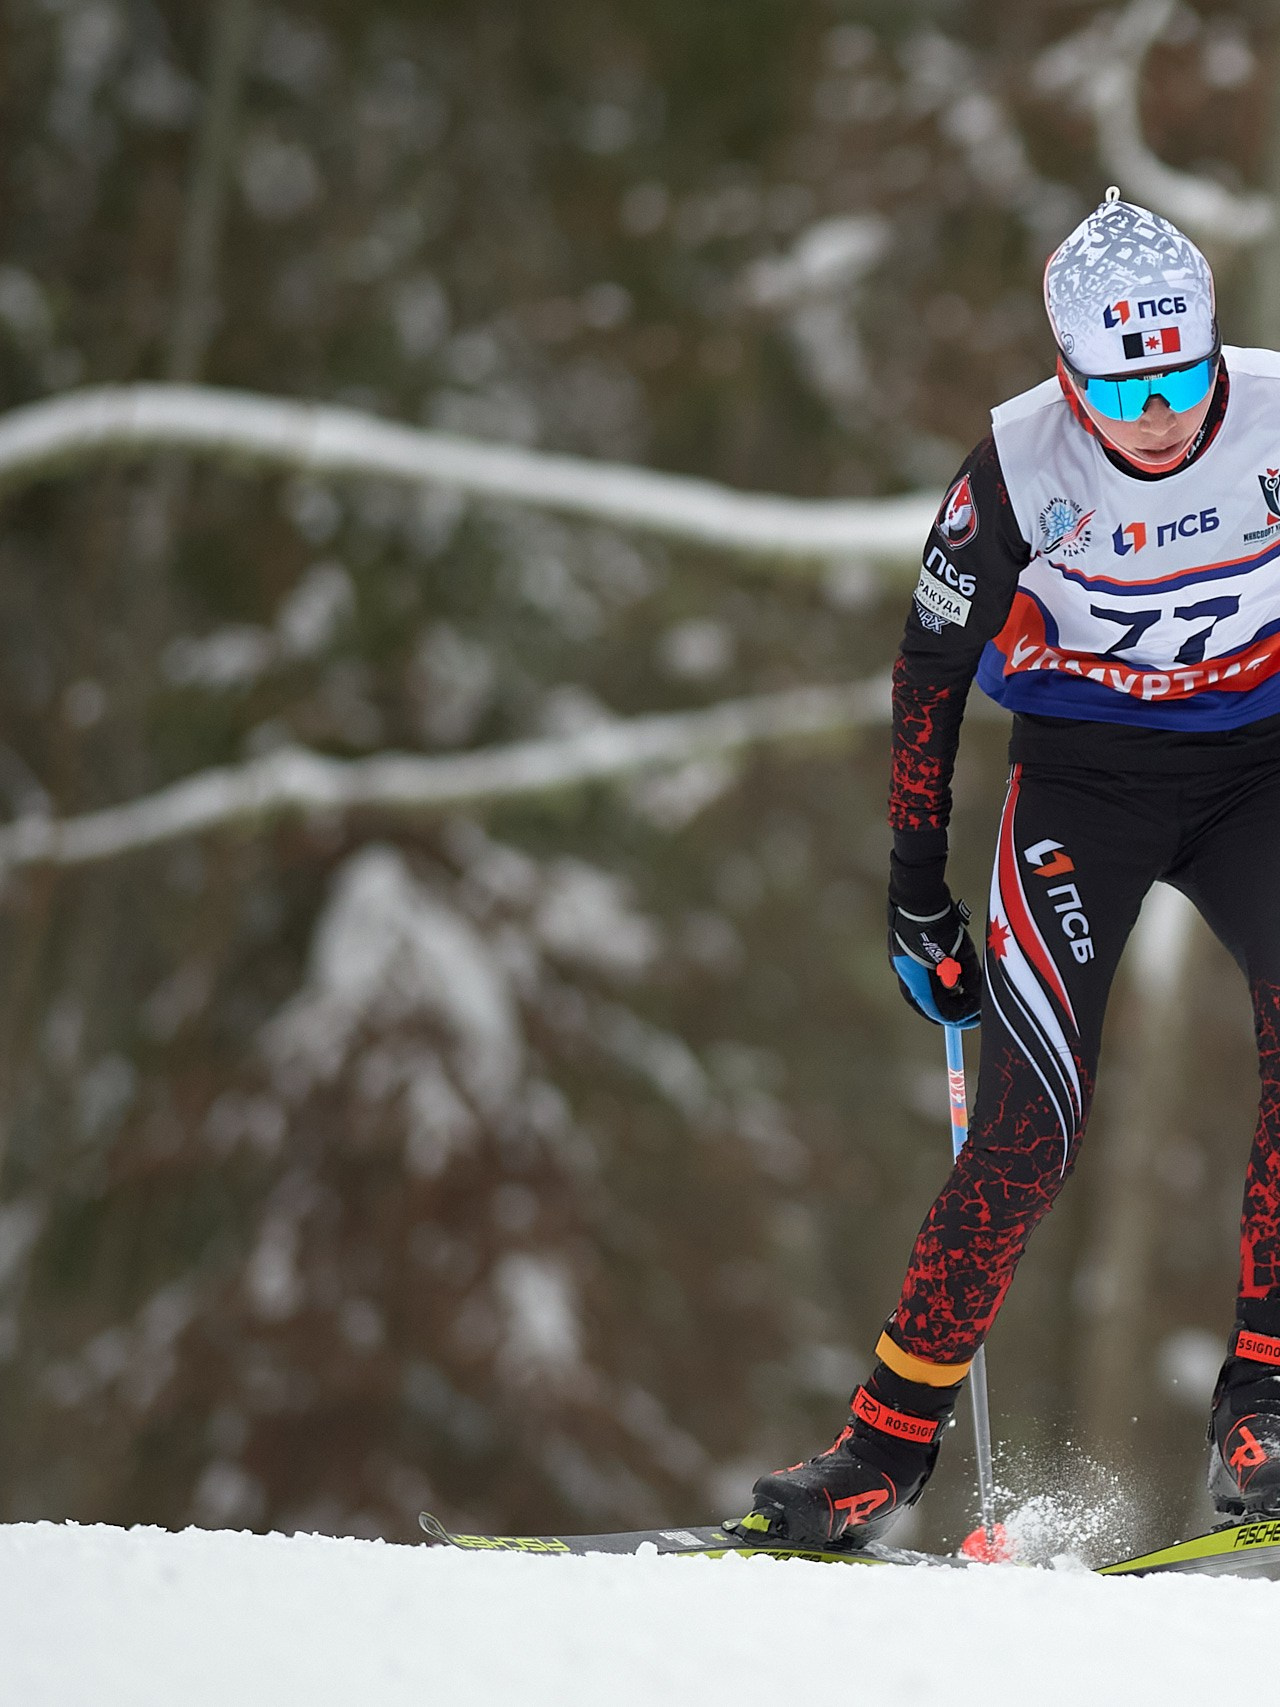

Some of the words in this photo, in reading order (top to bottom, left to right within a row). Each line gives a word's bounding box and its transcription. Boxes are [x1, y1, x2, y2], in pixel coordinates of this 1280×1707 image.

[1138, 296, 1187, 319] ПСБ
[1157, 507, 1220, 547] ПСБ
[926, 546, 977, 597] ПСБ
[919, 579, 961, 616] РАКУДА
[1090, 594, 1242, 667] 77
[1046, 883, 1095, 964] ПСБ
[885, 1416, 936, 1438] ROSSIGN
